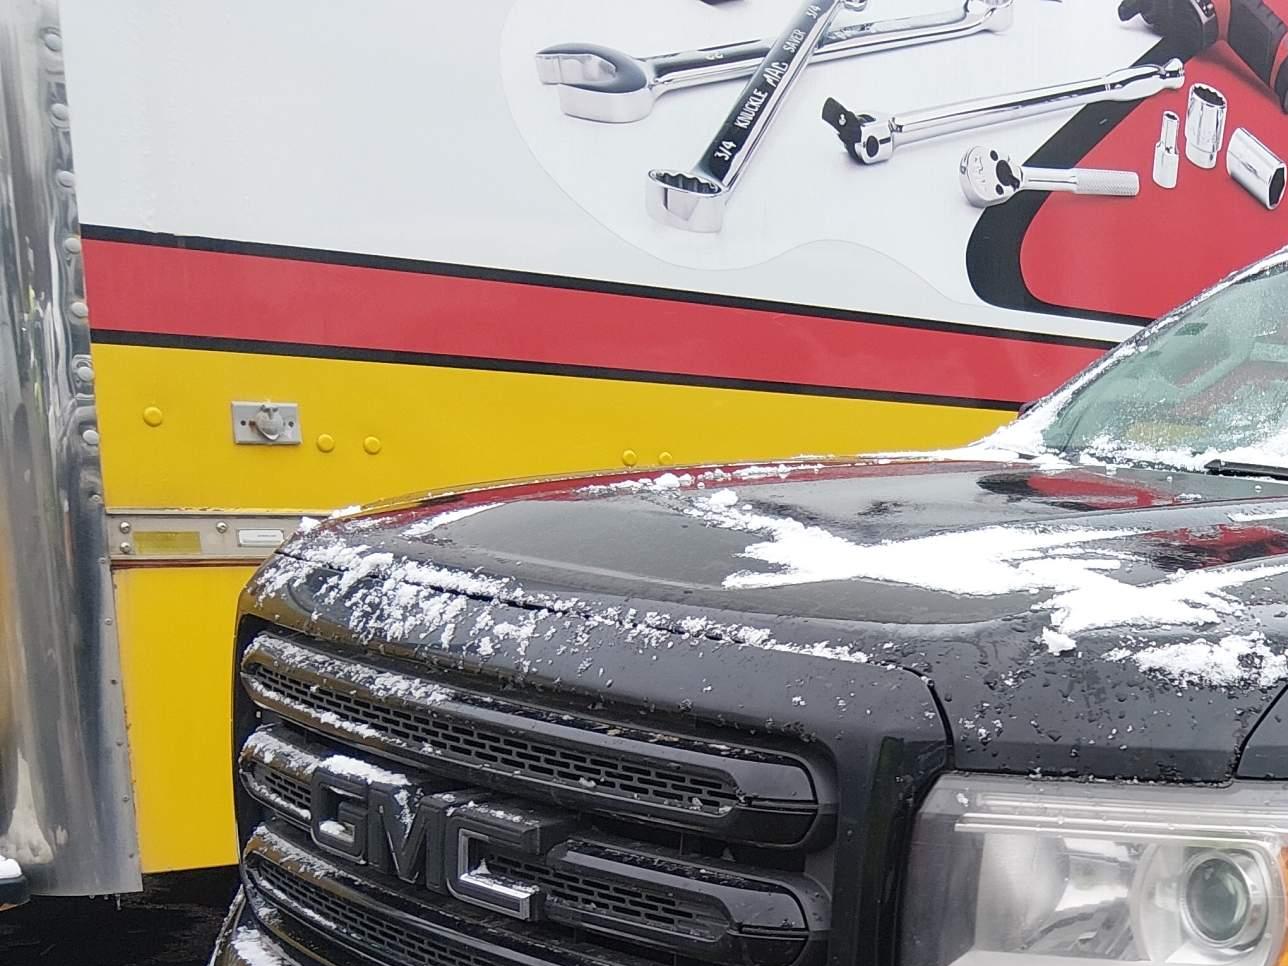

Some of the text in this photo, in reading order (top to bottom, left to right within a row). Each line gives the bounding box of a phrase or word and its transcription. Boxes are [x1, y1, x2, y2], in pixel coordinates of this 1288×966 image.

[714, 5, 822, 161] 3/4 KNUCKLE MAC SAVER 3/4
[310, 765, 541, 921] GMC
